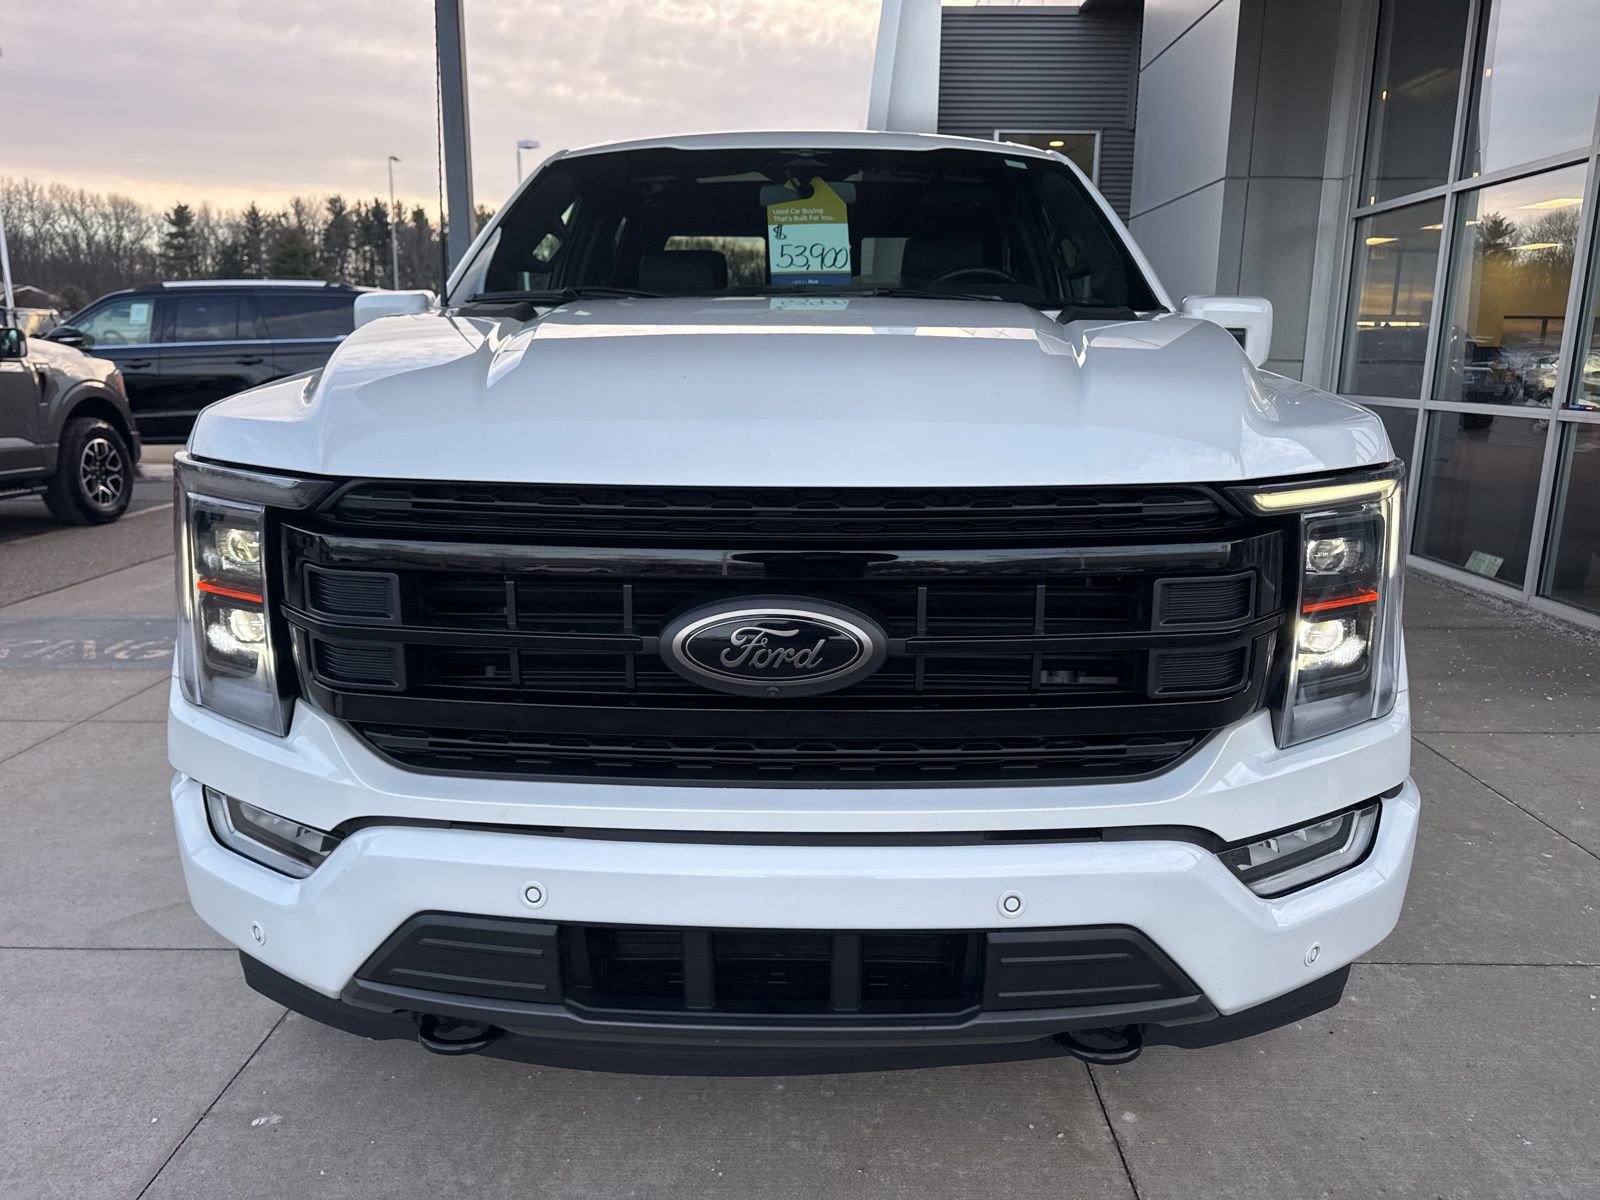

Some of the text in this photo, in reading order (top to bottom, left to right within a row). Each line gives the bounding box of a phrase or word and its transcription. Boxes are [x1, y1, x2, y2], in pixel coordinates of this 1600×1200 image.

[802, 208, 824, 216] Buying
[773, 224, 787, 240] $
[776, 243, 849, 270] 53,900
[720, 626, 826, 669] Ford
